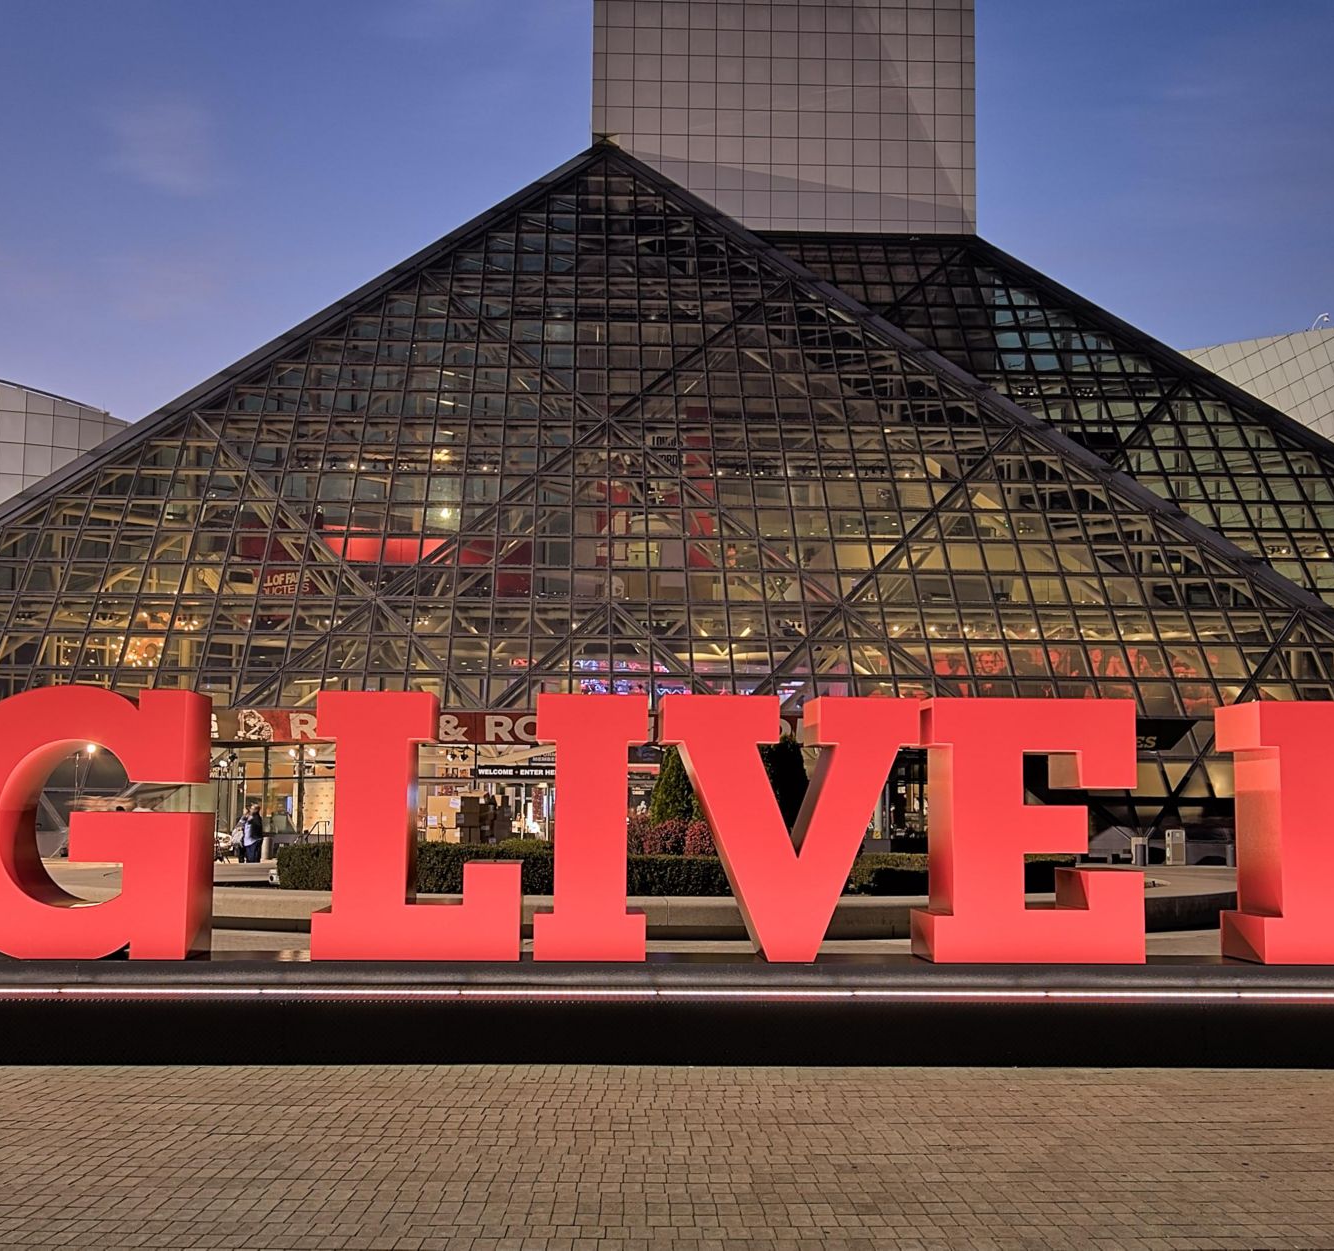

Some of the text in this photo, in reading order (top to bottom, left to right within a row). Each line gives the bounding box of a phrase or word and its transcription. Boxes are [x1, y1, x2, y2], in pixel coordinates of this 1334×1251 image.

[485, 715, 537, 742] RO
[478, 768, 514, 776] WELCOME
[309, 689, 1146, 964] LIVE
